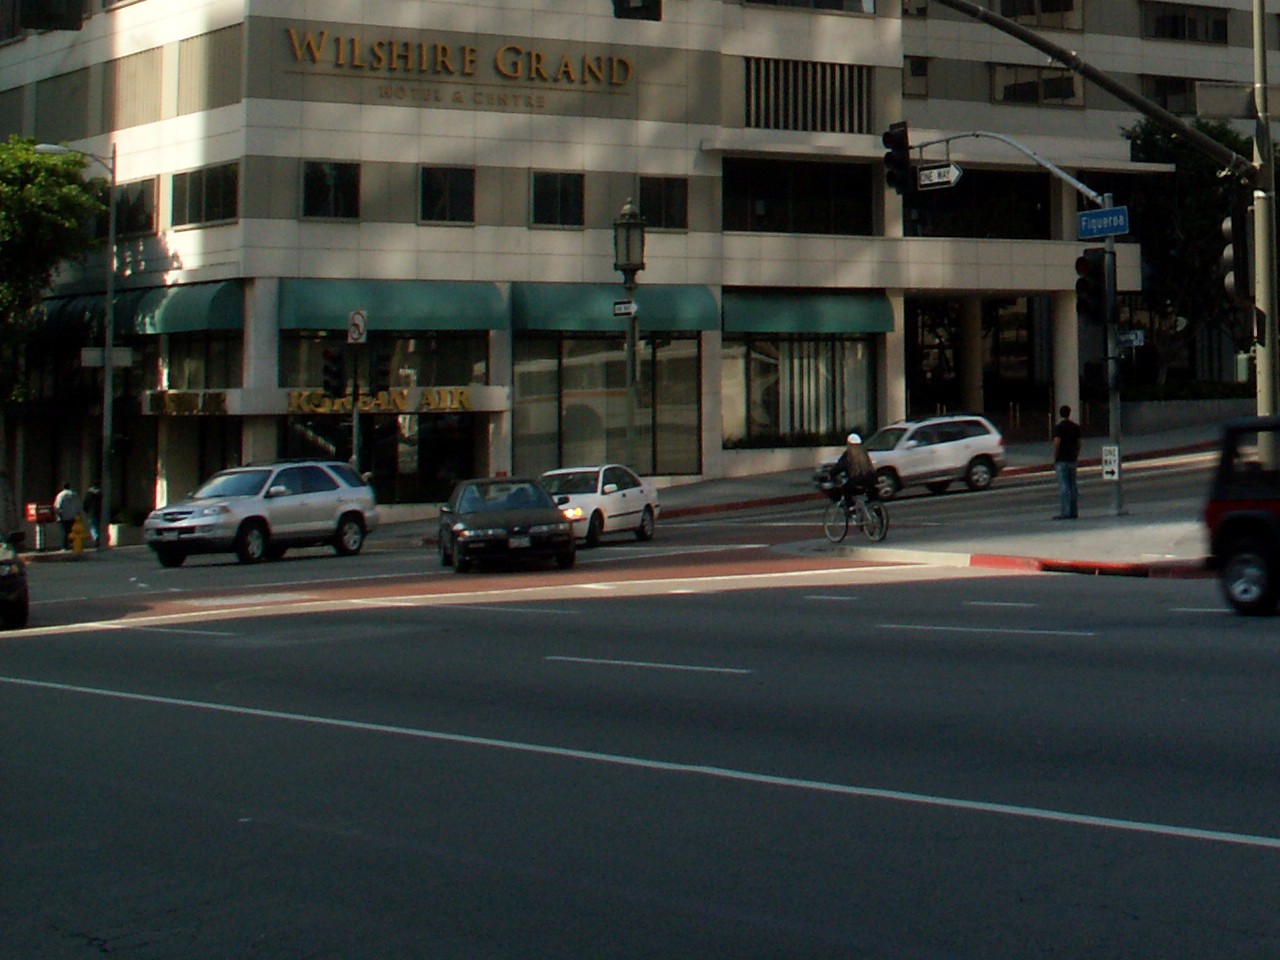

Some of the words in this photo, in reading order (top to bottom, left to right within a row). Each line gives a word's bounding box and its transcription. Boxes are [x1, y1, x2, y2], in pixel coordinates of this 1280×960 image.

[287, 28, 478, 77] WILSHIRE
[494, 45, 634, 87] GRAND
[379, 86, 443, 103] HOTEL
[452, 91, 465, 105] &
[473, 92, 546, 109] CENTRE
[920, 170, 933, 183] ONE
[937, 168, 951, 181] WAY
[1081, 214, 1125, 233] Figueroa
[418, 388, 472, 411] AIR
